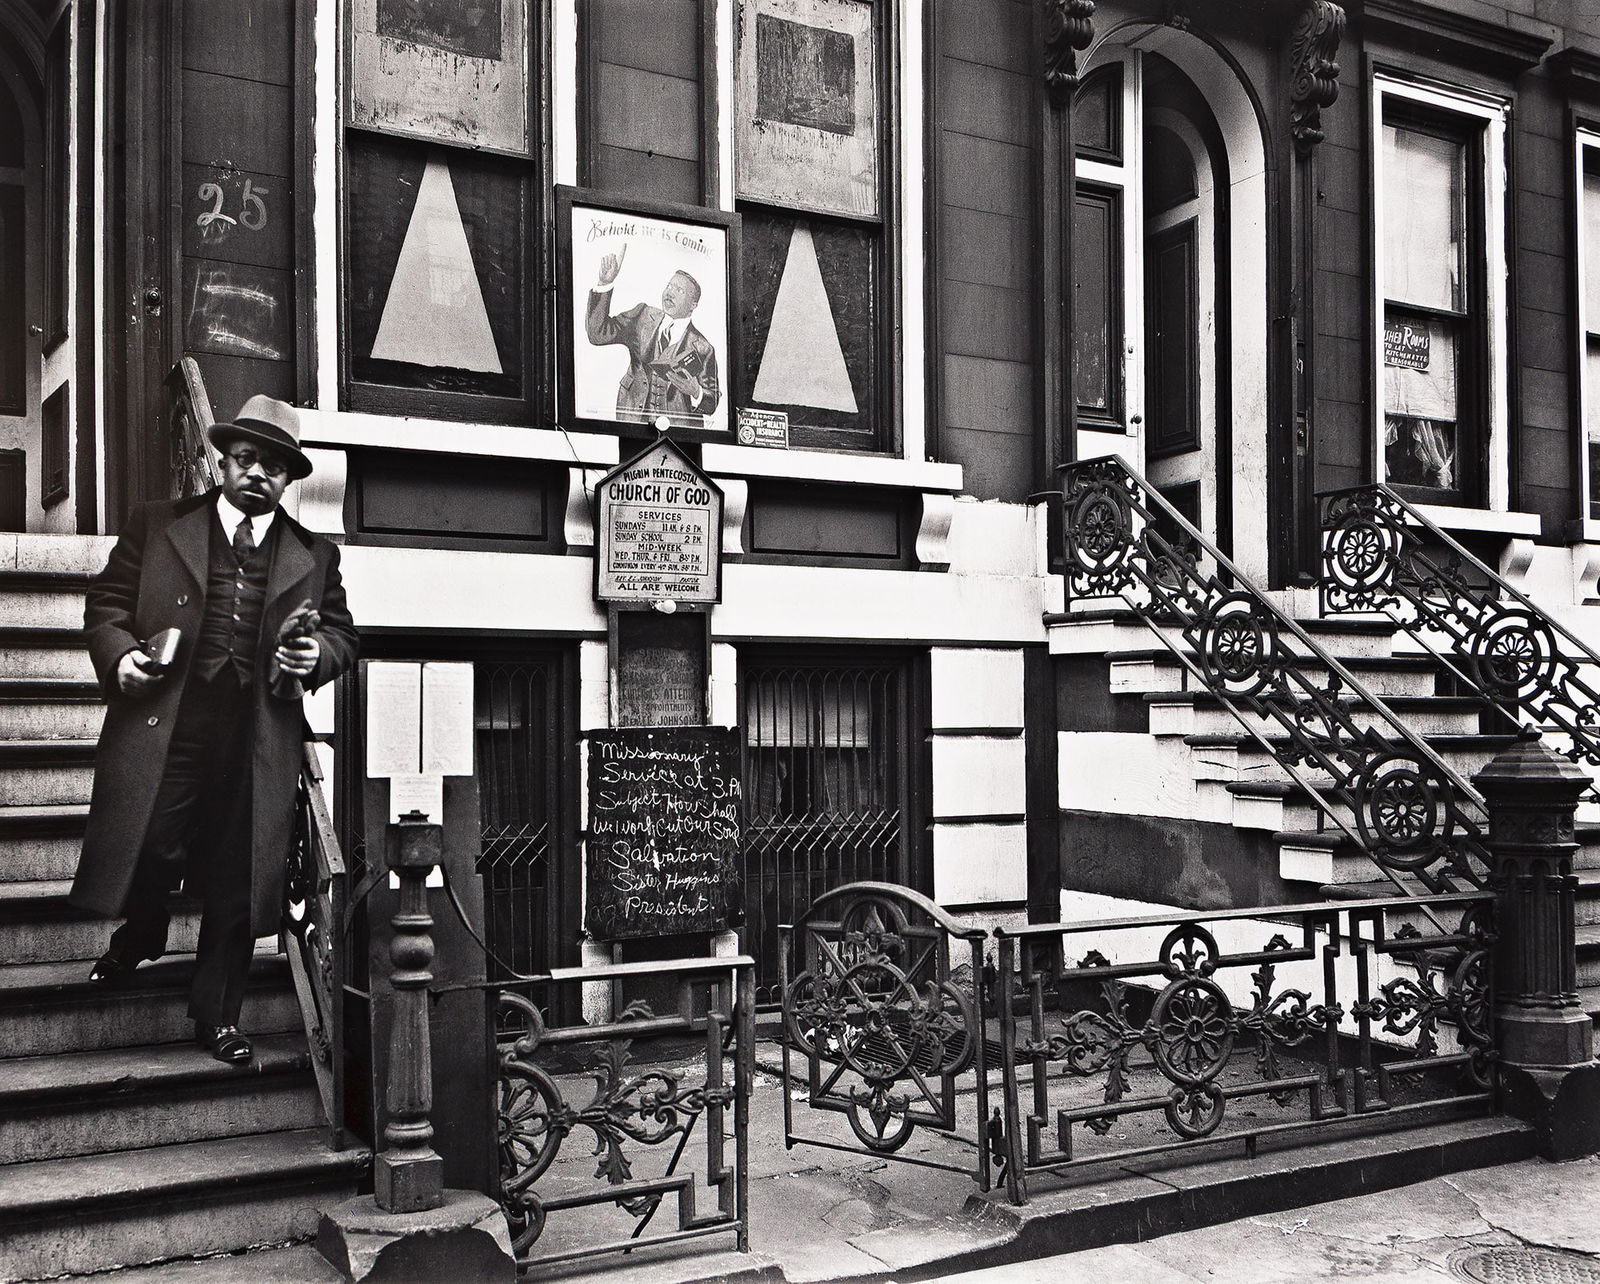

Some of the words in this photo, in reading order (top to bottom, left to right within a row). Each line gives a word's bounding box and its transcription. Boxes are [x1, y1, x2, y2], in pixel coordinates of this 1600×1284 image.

[197, 178, 269, 231] 25
[587, 219, 637, 241] Behold
[623, 468, 650, 483] PILGRIM
[652, 468, 698, 486] PENTECOSTAL
[609, 483, 661, 502] CHURCH
[666, 486, 681, 503] OF
[684, 488, 711, 505] GOD
[615, 521, 646, 530] SUNDAYS
[638, 511, 682, 521] SERVICES
[614, 532, 638, 541] SUNDAY
[641, 533, 664, 542] SCHOOL
[684, 535, 690, 544] 2
[618, 583, 638, 591] ALL
[641, 583, 660, 591] ARE
[664, 584, 700, 592] WELCOME
[595, 741, 705, 771] Missionary
[600, 762, 683, 789] Service
[684, 770, 709, 790] at
[608, 840, 720, 870] Salvation
